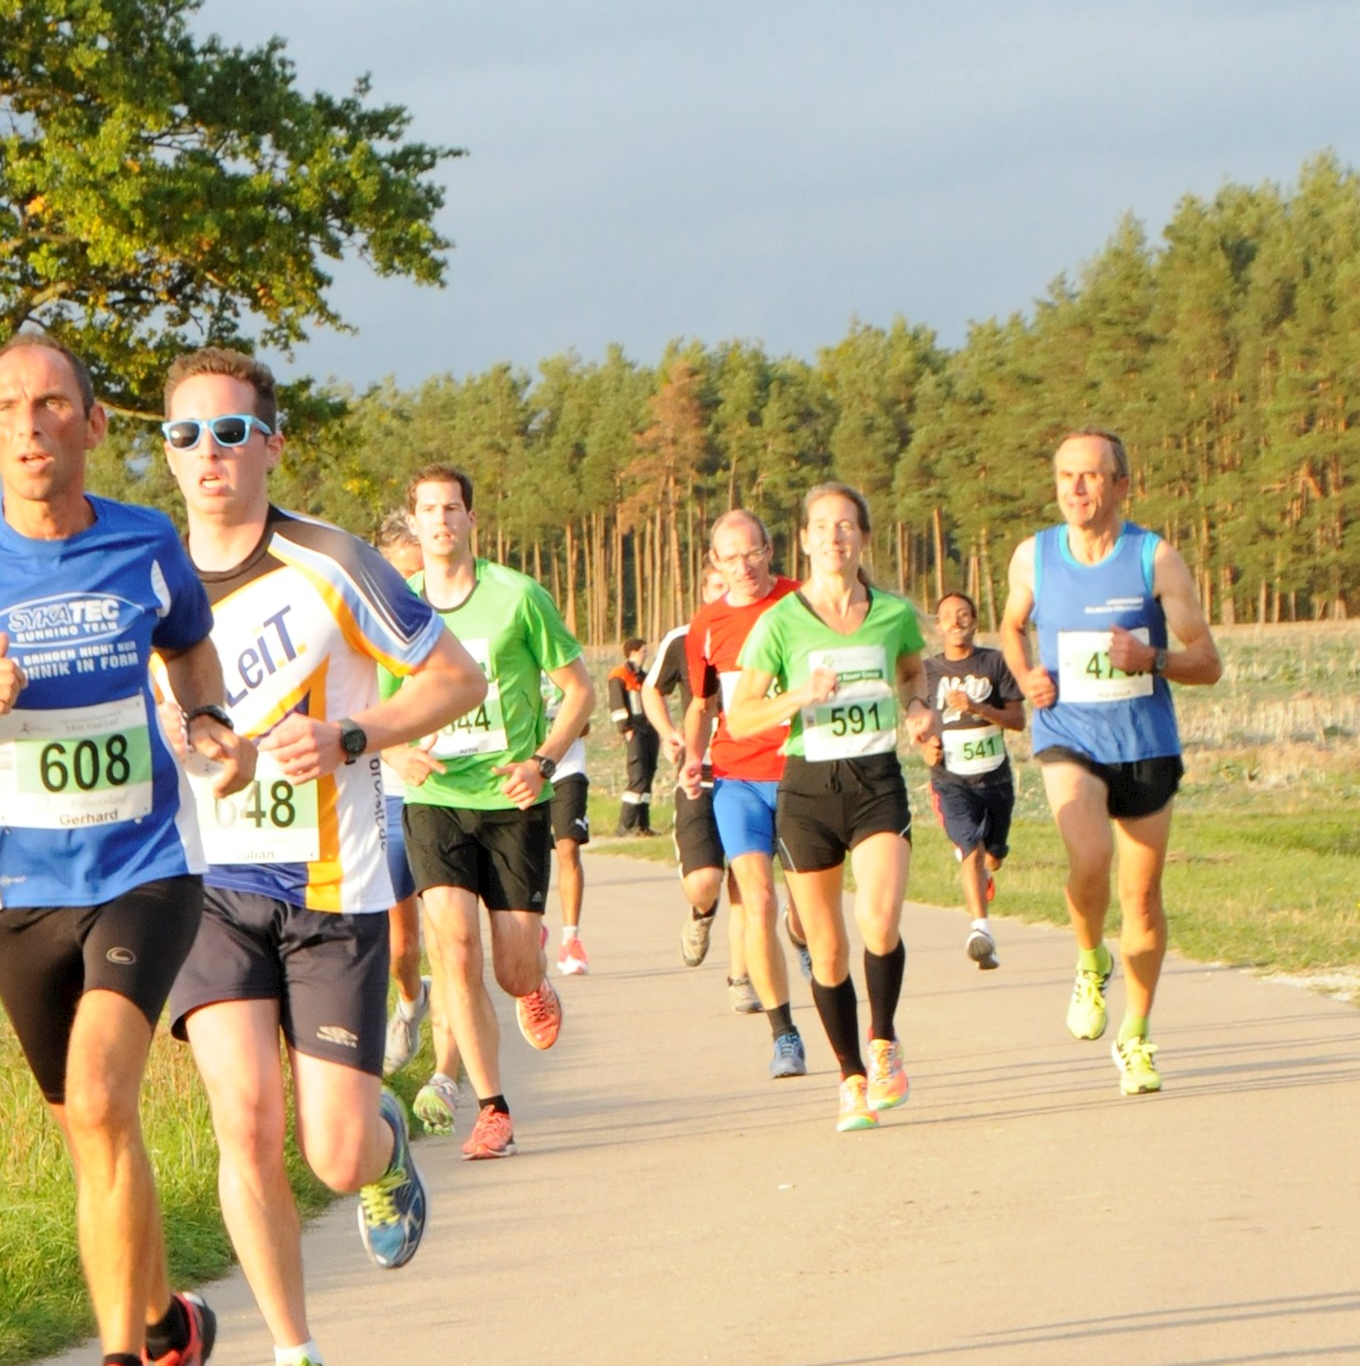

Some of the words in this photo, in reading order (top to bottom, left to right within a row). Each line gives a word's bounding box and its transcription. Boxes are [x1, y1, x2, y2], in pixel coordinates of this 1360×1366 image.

[8, 599, 120, 632] SYKATEC
[16, 625, 79, 643] RUNNING
[83, 621, 119, 633] TEAM
[23, 647, 76, 666] BRINGEN
[79, 643, 114, 658] NICHT
[76, 657, 95, 674] IN
[101, 652, 139, 670] FORM
[831, 701, 881, 737] 591
[963, 737, 996, 761] 541
[40, 733, 131, 793] 608
[59, 808, 119, 826] Gerhard
